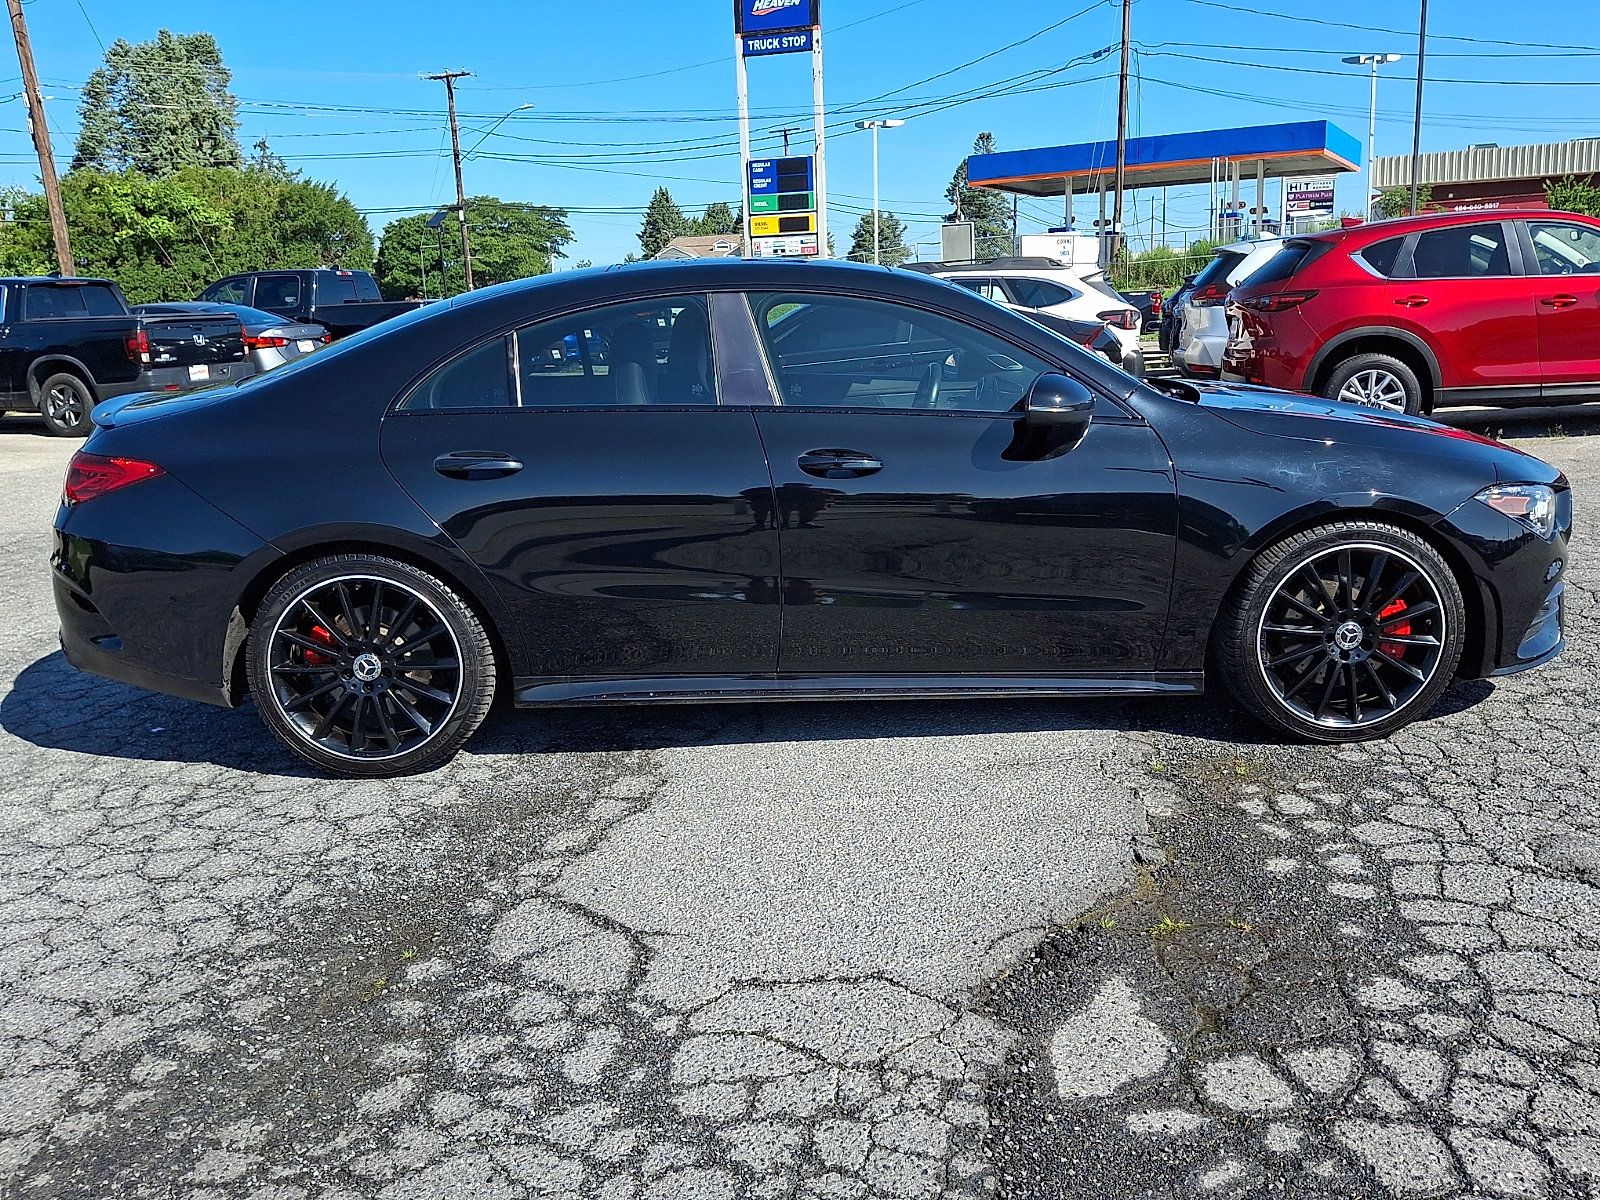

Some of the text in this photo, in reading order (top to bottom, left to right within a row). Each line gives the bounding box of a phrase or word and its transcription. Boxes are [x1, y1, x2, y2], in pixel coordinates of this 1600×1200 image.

[747, 35, 807, 51] TRUCK STOP
[1290, 182, 1312, 191] HIT
[1295, 192, 1320, 200] PLATINUM
